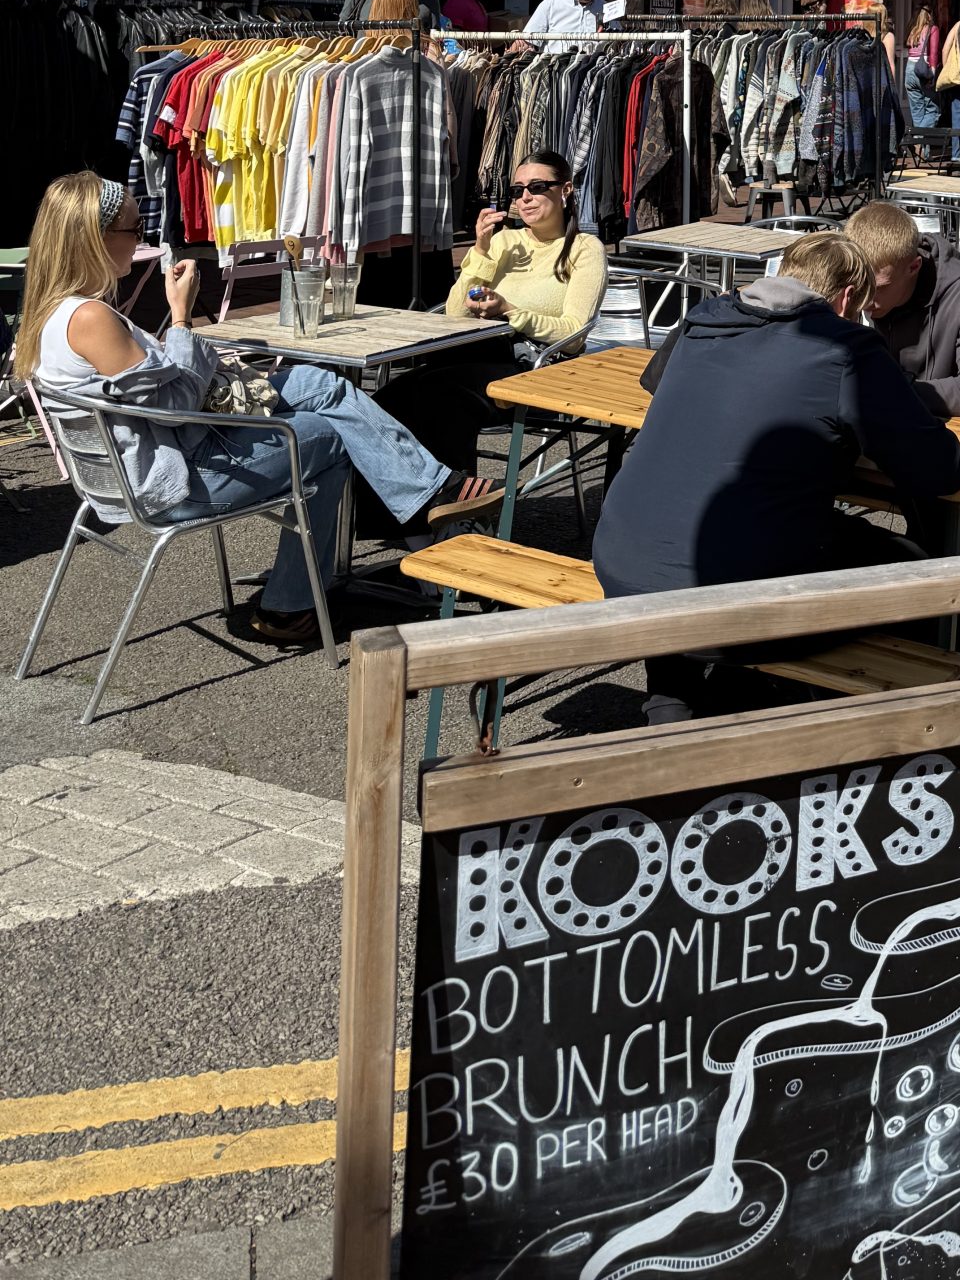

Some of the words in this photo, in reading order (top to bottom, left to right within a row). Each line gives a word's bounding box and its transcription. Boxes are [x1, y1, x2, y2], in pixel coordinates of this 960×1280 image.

[454, 753, 957, 963] KOOKS
[422, 899, 838, 1055] BOTTOMLESS
[414, 1139, 519, 1215] £30
[535, 1116, 606, 1180] PER
[621, 1096, 699, 1152] HEAD
[415, 1014, 693, 1151] BRUNCH
